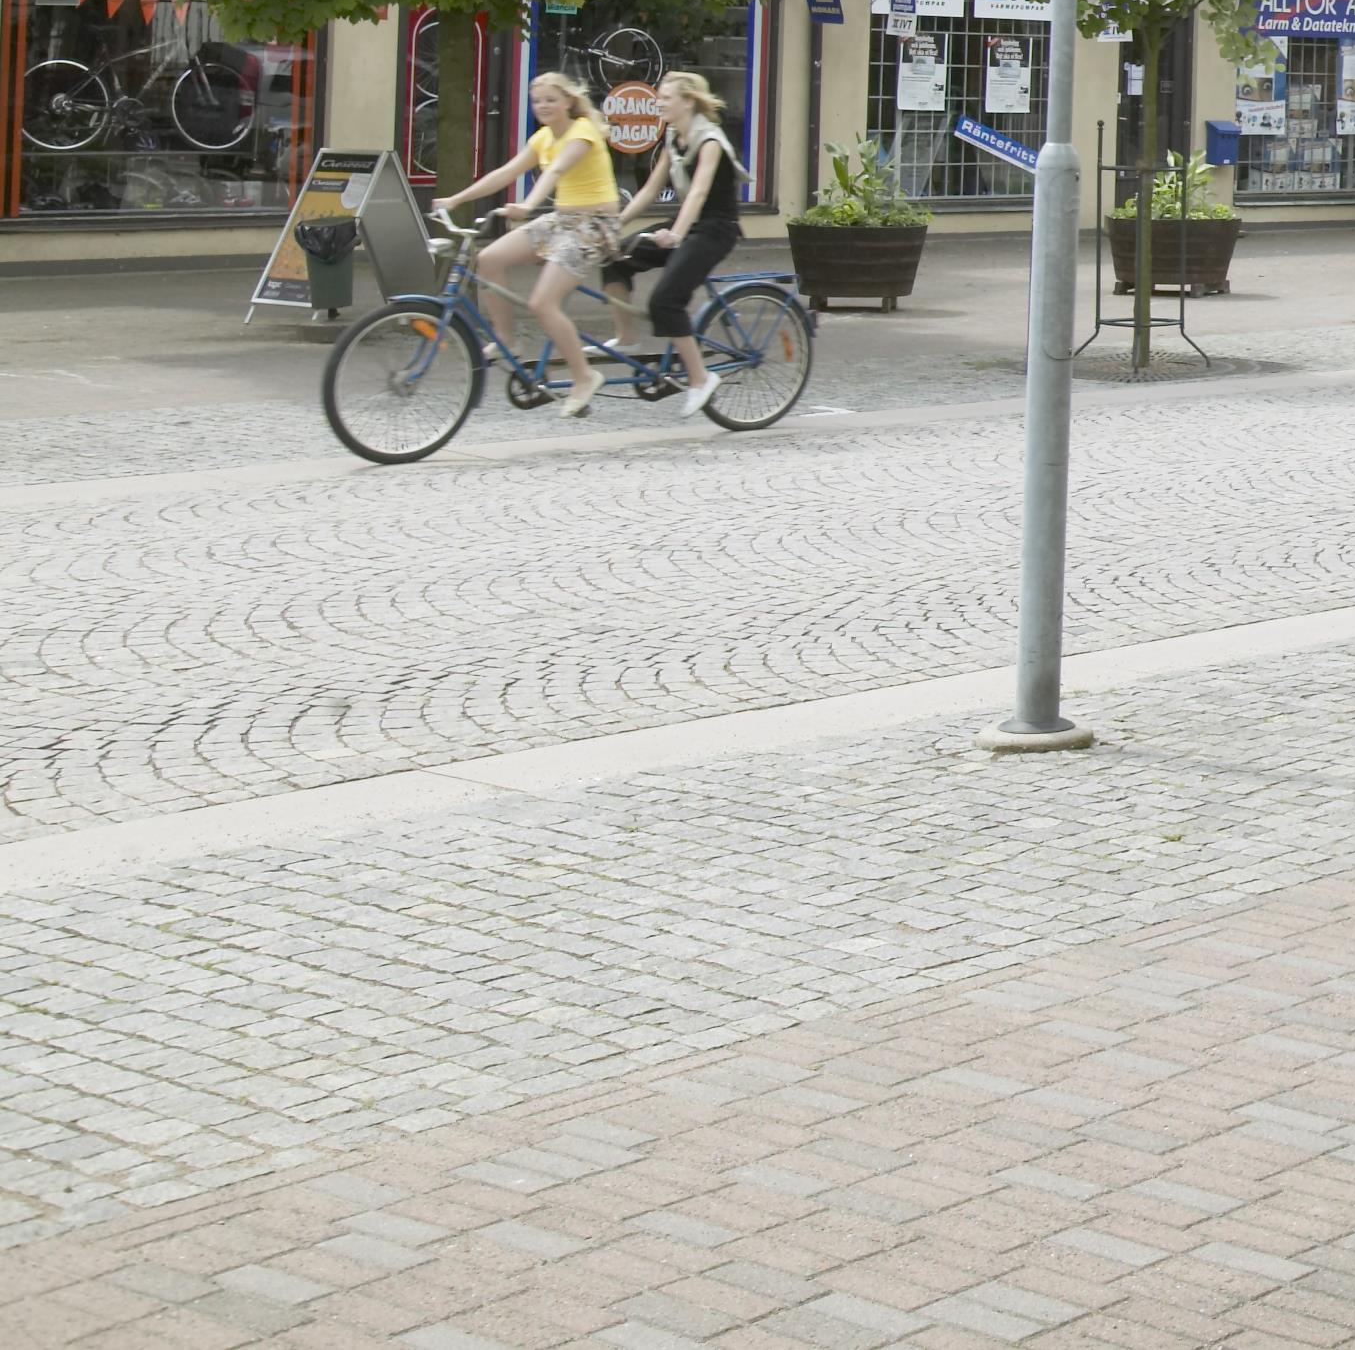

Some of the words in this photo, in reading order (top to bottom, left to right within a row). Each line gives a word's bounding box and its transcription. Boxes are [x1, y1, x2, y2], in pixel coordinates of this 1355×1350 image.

[1258, 16, 1289, 30] Larm
[1291, 17, 1301, 30] &
[610, 124, 658, 142] DAGAR
[961, 119, 1036, 164] Räntefritt
